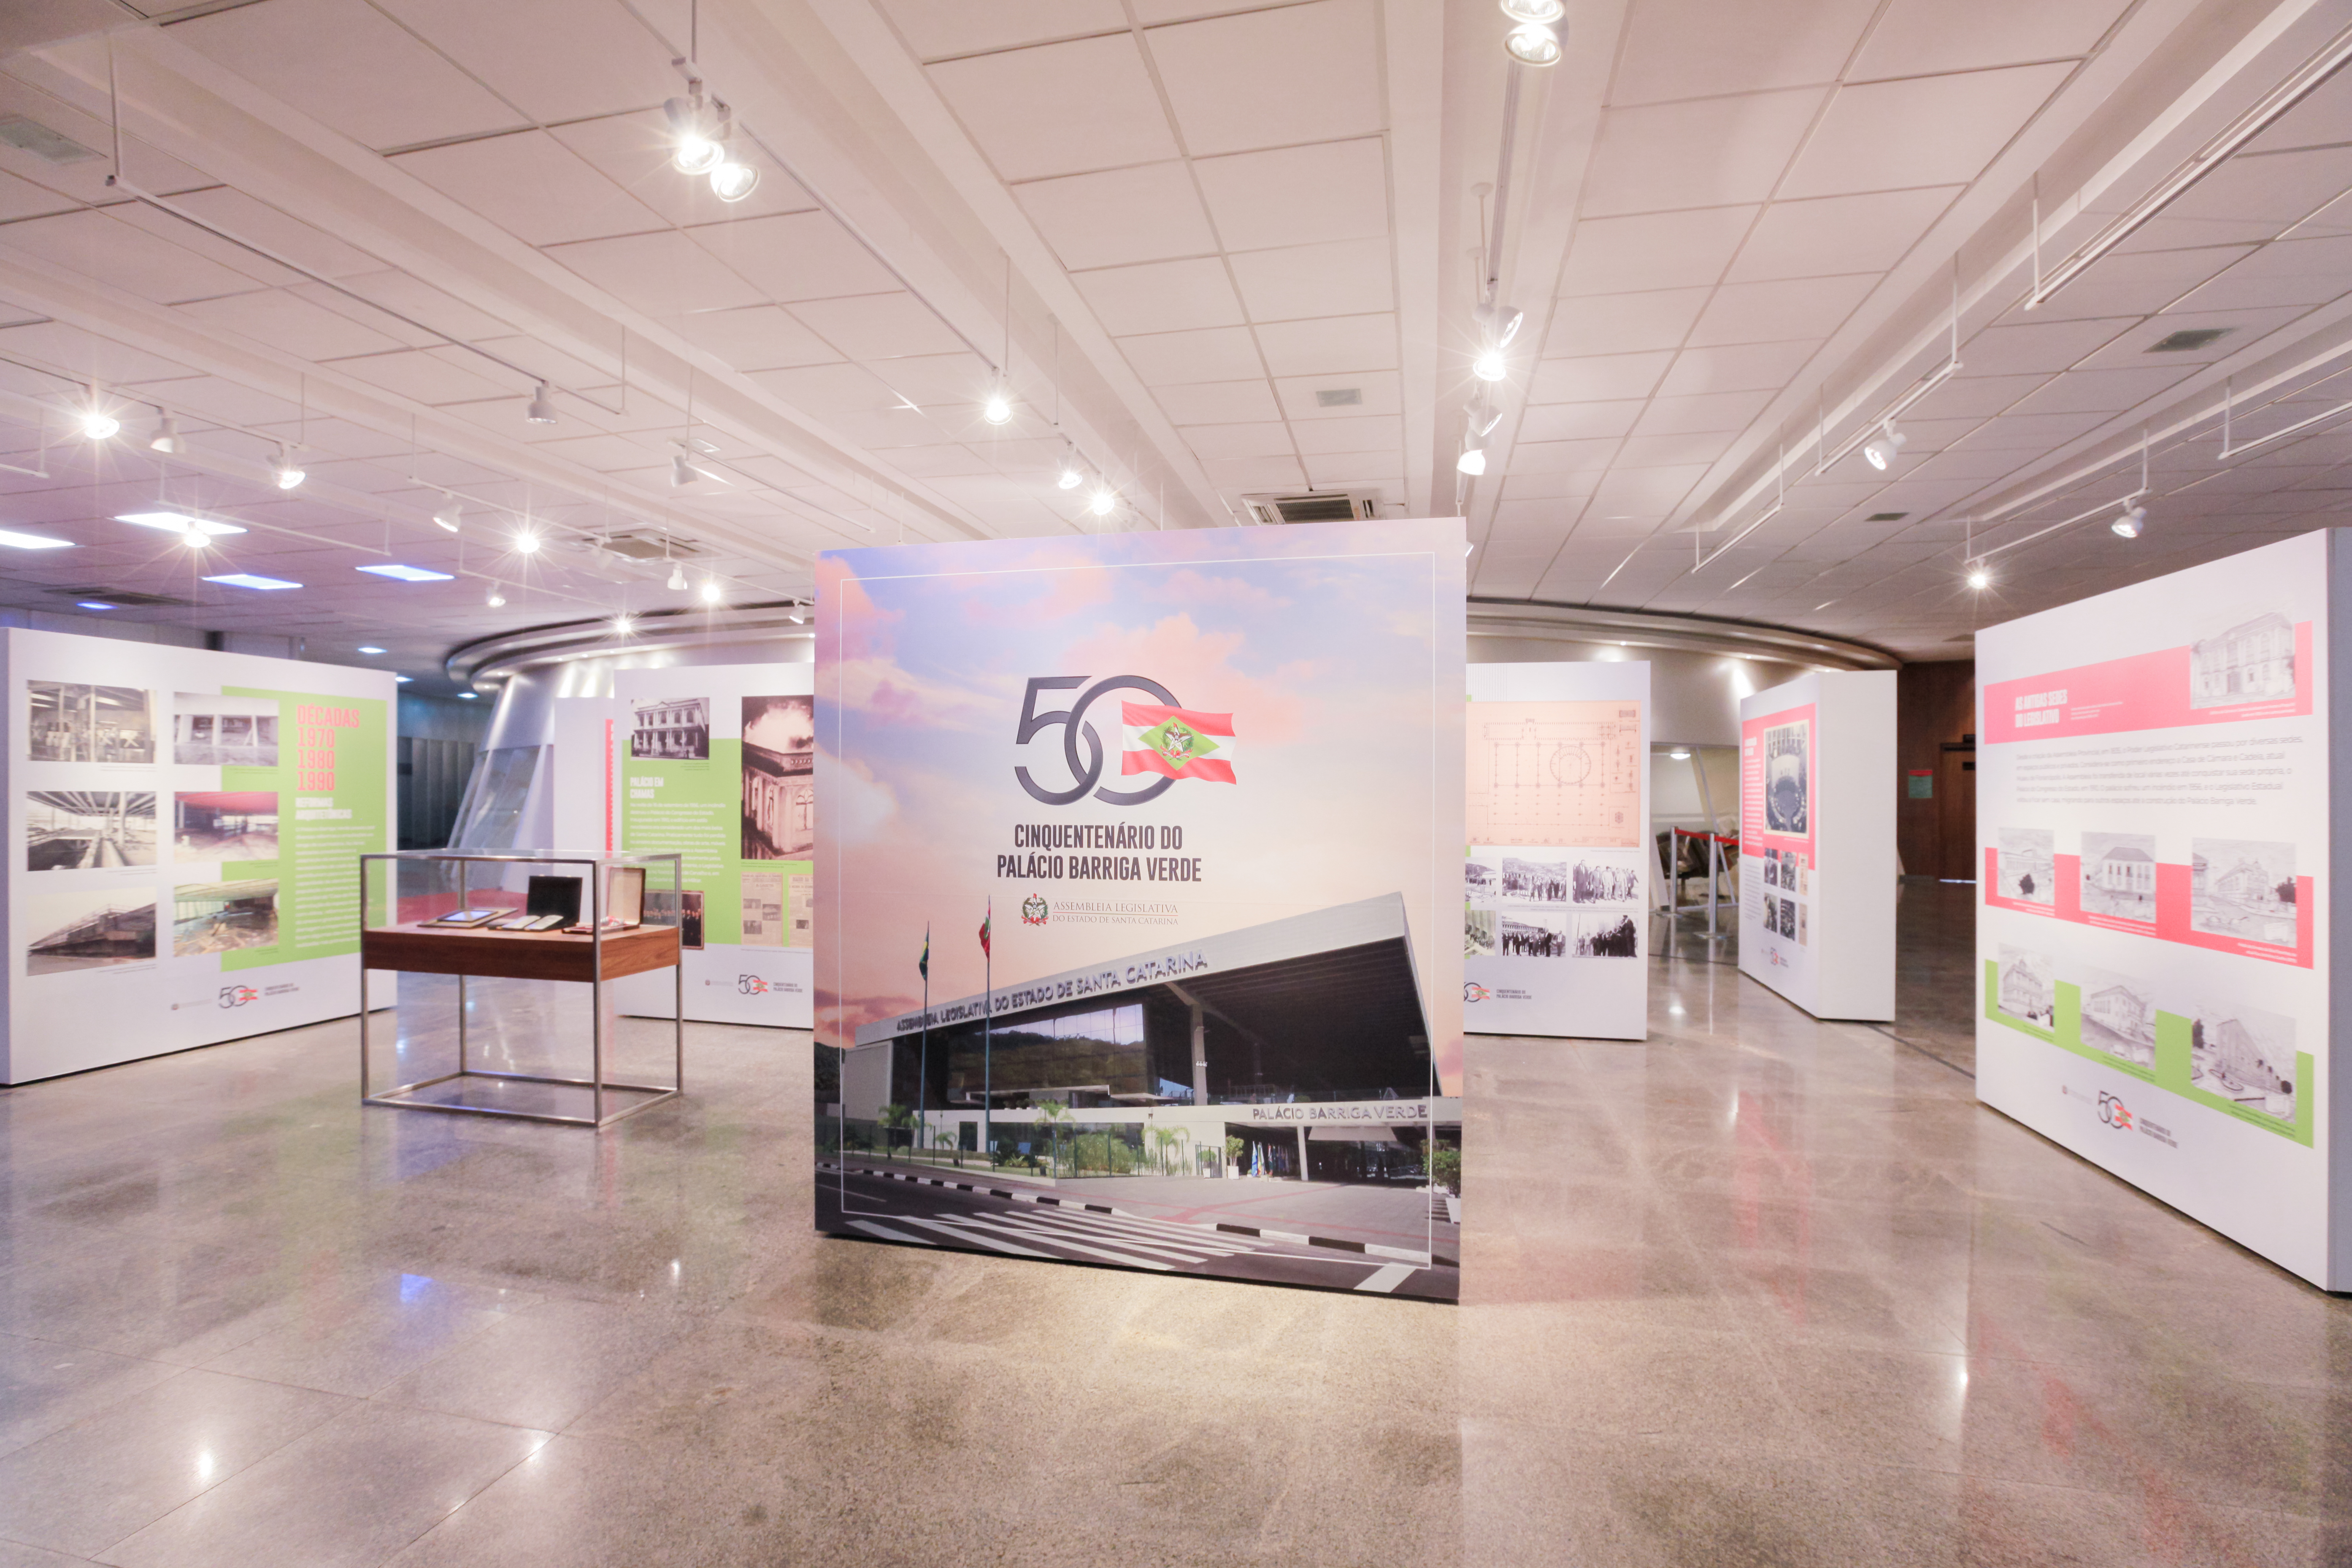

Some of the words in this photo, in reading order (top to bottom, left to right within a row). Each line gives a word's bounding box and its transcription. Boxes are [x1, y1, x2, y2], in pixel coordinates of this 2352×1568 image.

[297, 703, 360, 728] DÉCADAS
[297, 727, 335, 748] 1970
[1014, 675, 1183, 806] 50
[297, 749, 335, 769] 1980
[297, 771, 335, 791] 1990
[654, 777, 665, 787] EM
[1014, 822, 1154, 851] CINQUENTENÁRIO
[1160, 826, 1182, 850] DO
[998, 852, 1063, 879] PALÁCIO
[1069, 856, 1141, 881] BARRIGA
[1146, 857, 1202, 882] VERDE
[1054, 902, 1112, 912] ASSEMBLEIA
[1115, 903, 1178, 913] LEGISLATIVA
[1068, 915, 1097, 923] ESTADO
[1138, 917, 1179, 925] CATARINA
[995, 996, 1009, 1012] DO
[1011, 984, 1053, 1008] ESTADO
[1057, 980, 1073, 999] DE
[1076, 970, 1121, 995] SANTA
[1125, 949, 1208, 984] CATARINA
[1253, 1106, 1304, 1119] PALÁCIO
[1310, 1106, 1372, 1119] BARRIGA
[1373, 1104, 1427, 1118] VERDE
